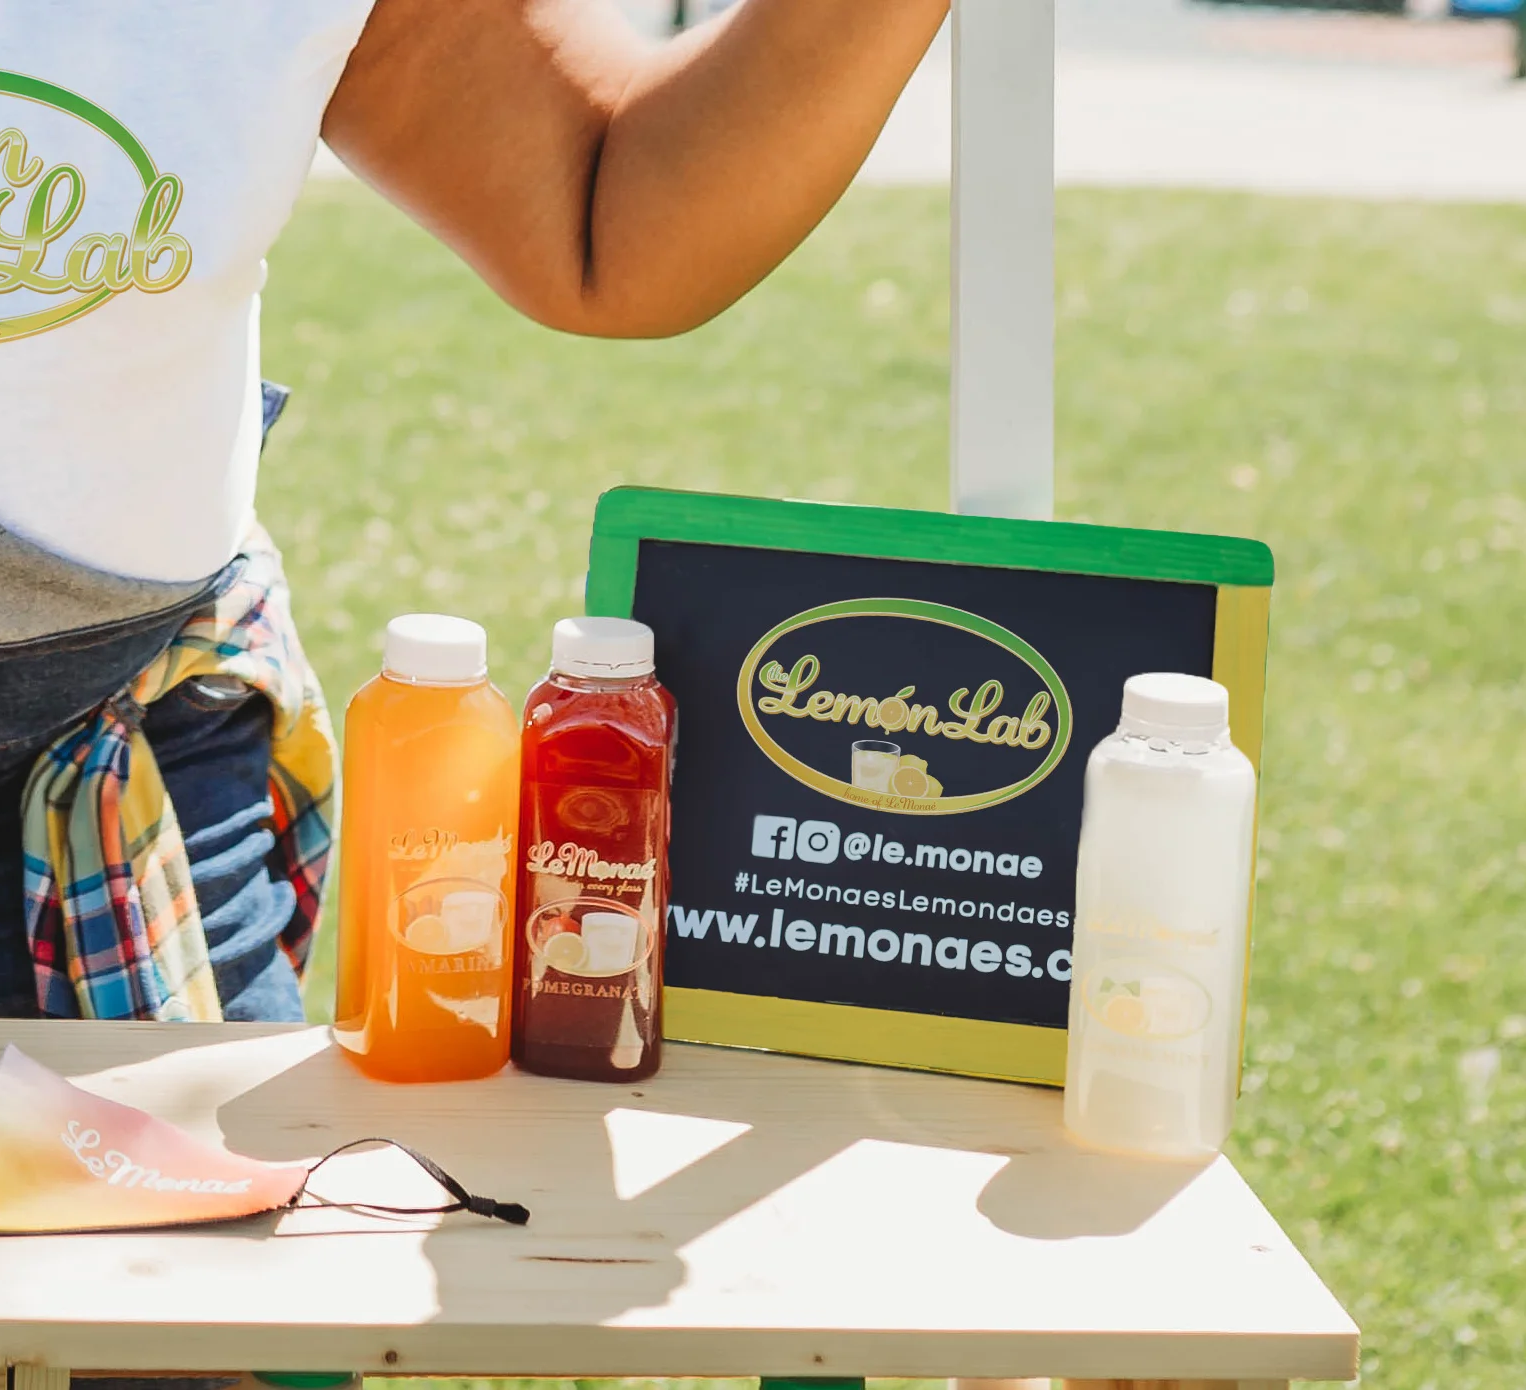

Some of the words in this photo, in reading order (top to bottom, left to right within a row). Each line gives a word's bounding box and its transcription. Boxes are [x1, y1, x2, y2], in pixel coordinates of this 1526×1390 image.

[768, 664, 789, 683] the
[941, 679, 1051, 749] Lab
[843, 787, 869, 804] home
[871, 796, 884, 811] of
[843, 832, 1044, 879] @le.monae
[734, 871, 1071, 928] #LeMonaesLemondaes
[665, 904, 1073, 982] ww.lemonaes.c
